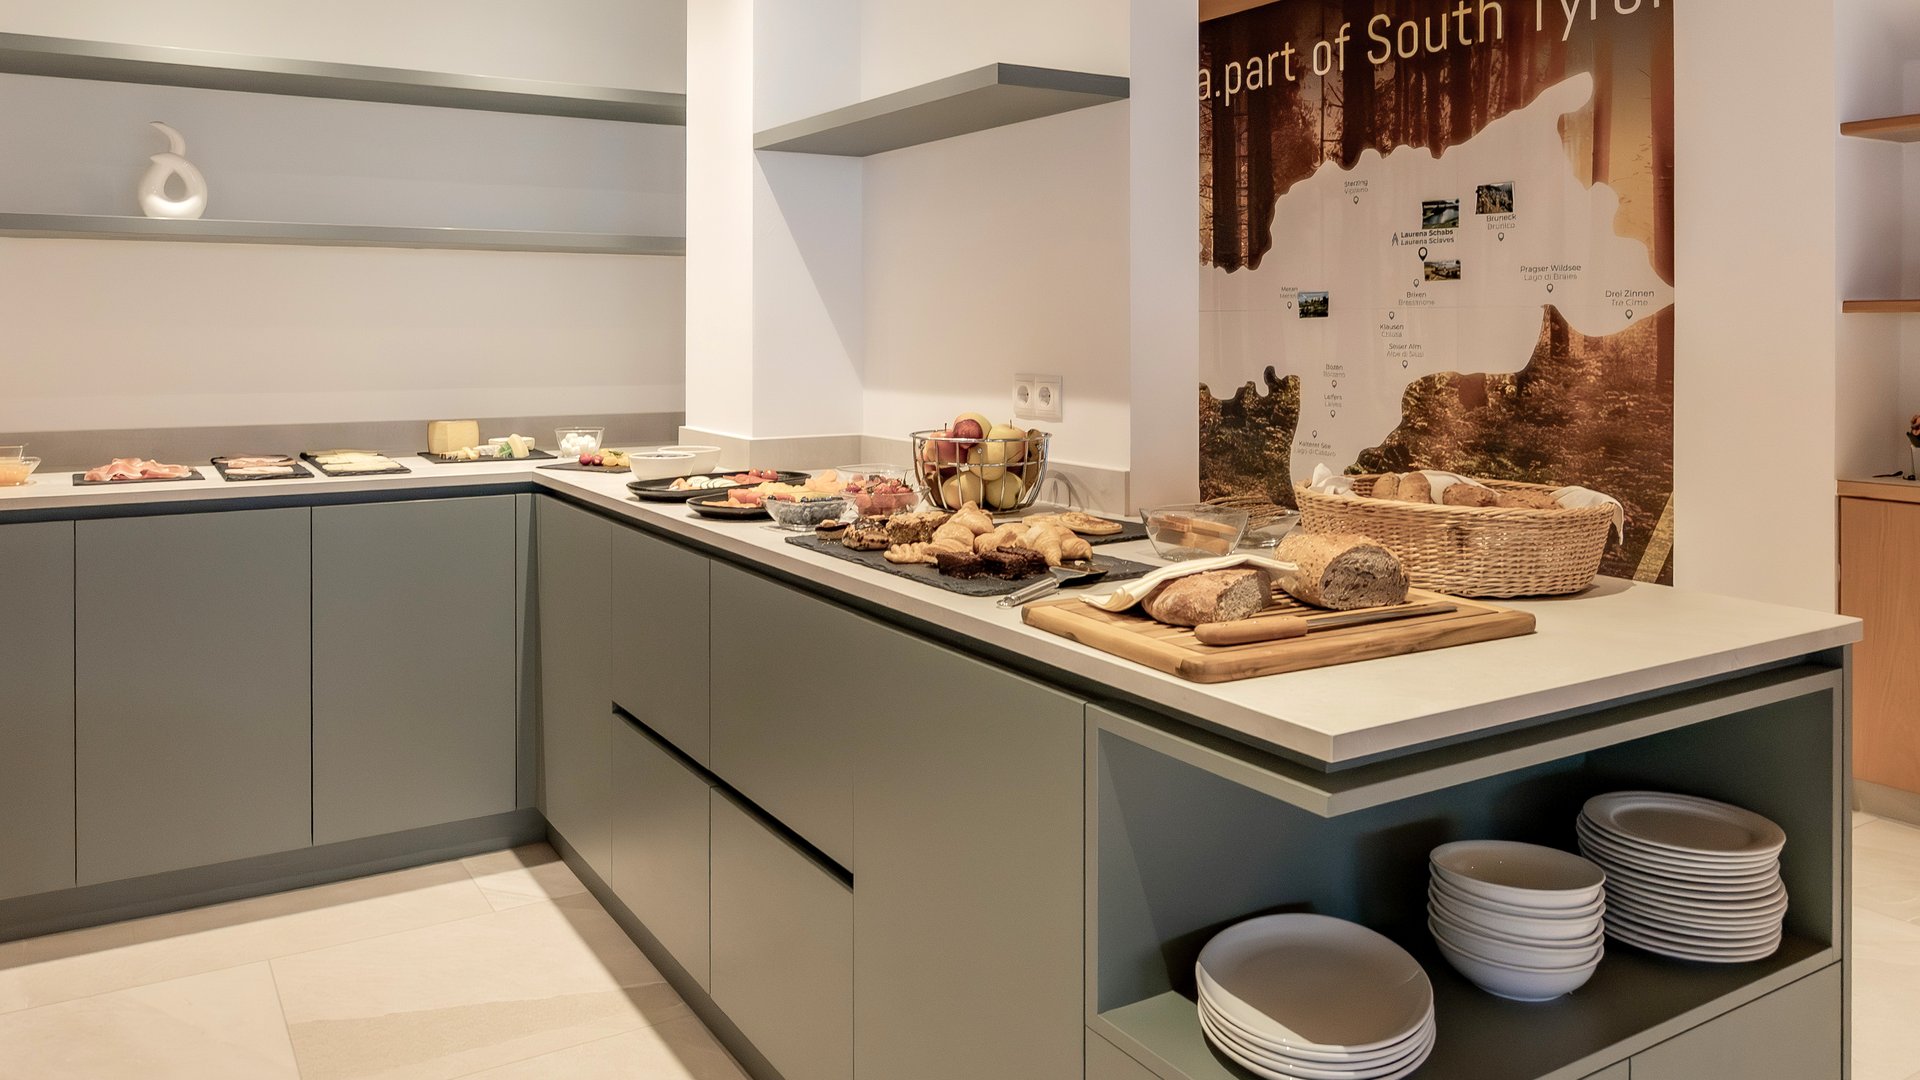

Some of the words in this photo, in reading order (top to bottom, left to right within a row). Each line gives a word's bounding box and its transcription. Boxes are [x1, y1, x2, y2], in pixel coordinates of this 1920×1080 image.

[1313, 22, 1351, 76] of
[1368, 0, 1503, 65] South
[1486, 214, 1516, 222] Bruneck
[1401, 230, 1428, 238] Laurena
[1428, 228, 1454, 236] Schabs
[1520, 265, 1549, 274] Pragser
[1550, 264, 1582, 272] Wildsee
[1624, 290, 1655, 298] Zinnen
